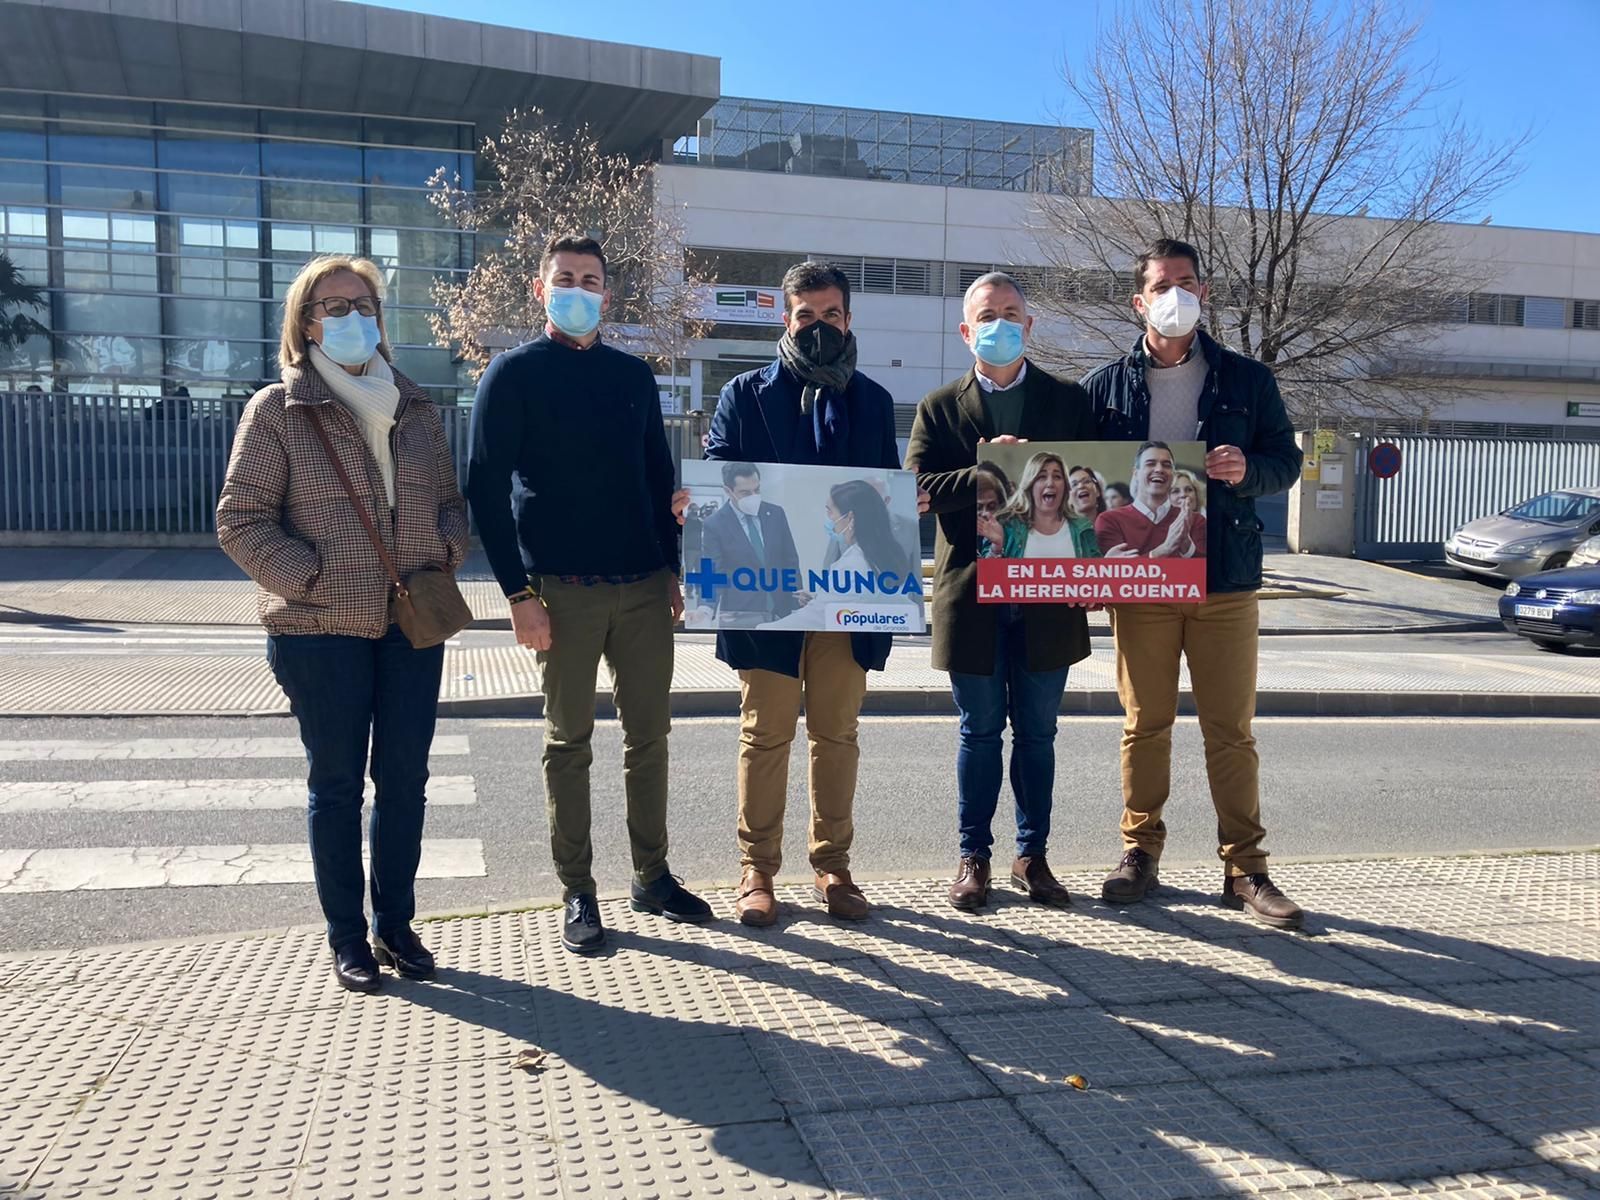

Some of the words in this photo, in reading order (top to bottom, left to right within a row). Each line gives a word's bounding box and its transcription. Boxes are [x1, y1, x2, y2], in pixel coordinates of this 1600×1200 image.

[1007, 565, 1034, 578] EN
[1041, 565, 1066, 578] LA
[1072, 565, 1167, 581] SANIDAD,
[732, 567, 797, 592] QUE
[808, 570, 922, 596] NUNCA
[979, 584, 1004, 598] LA
[1010, 584, 1113, 598] HERENCIA
[1119, 584, 1201, 598] CUENTA
[844, 613, 906, 626] populares
